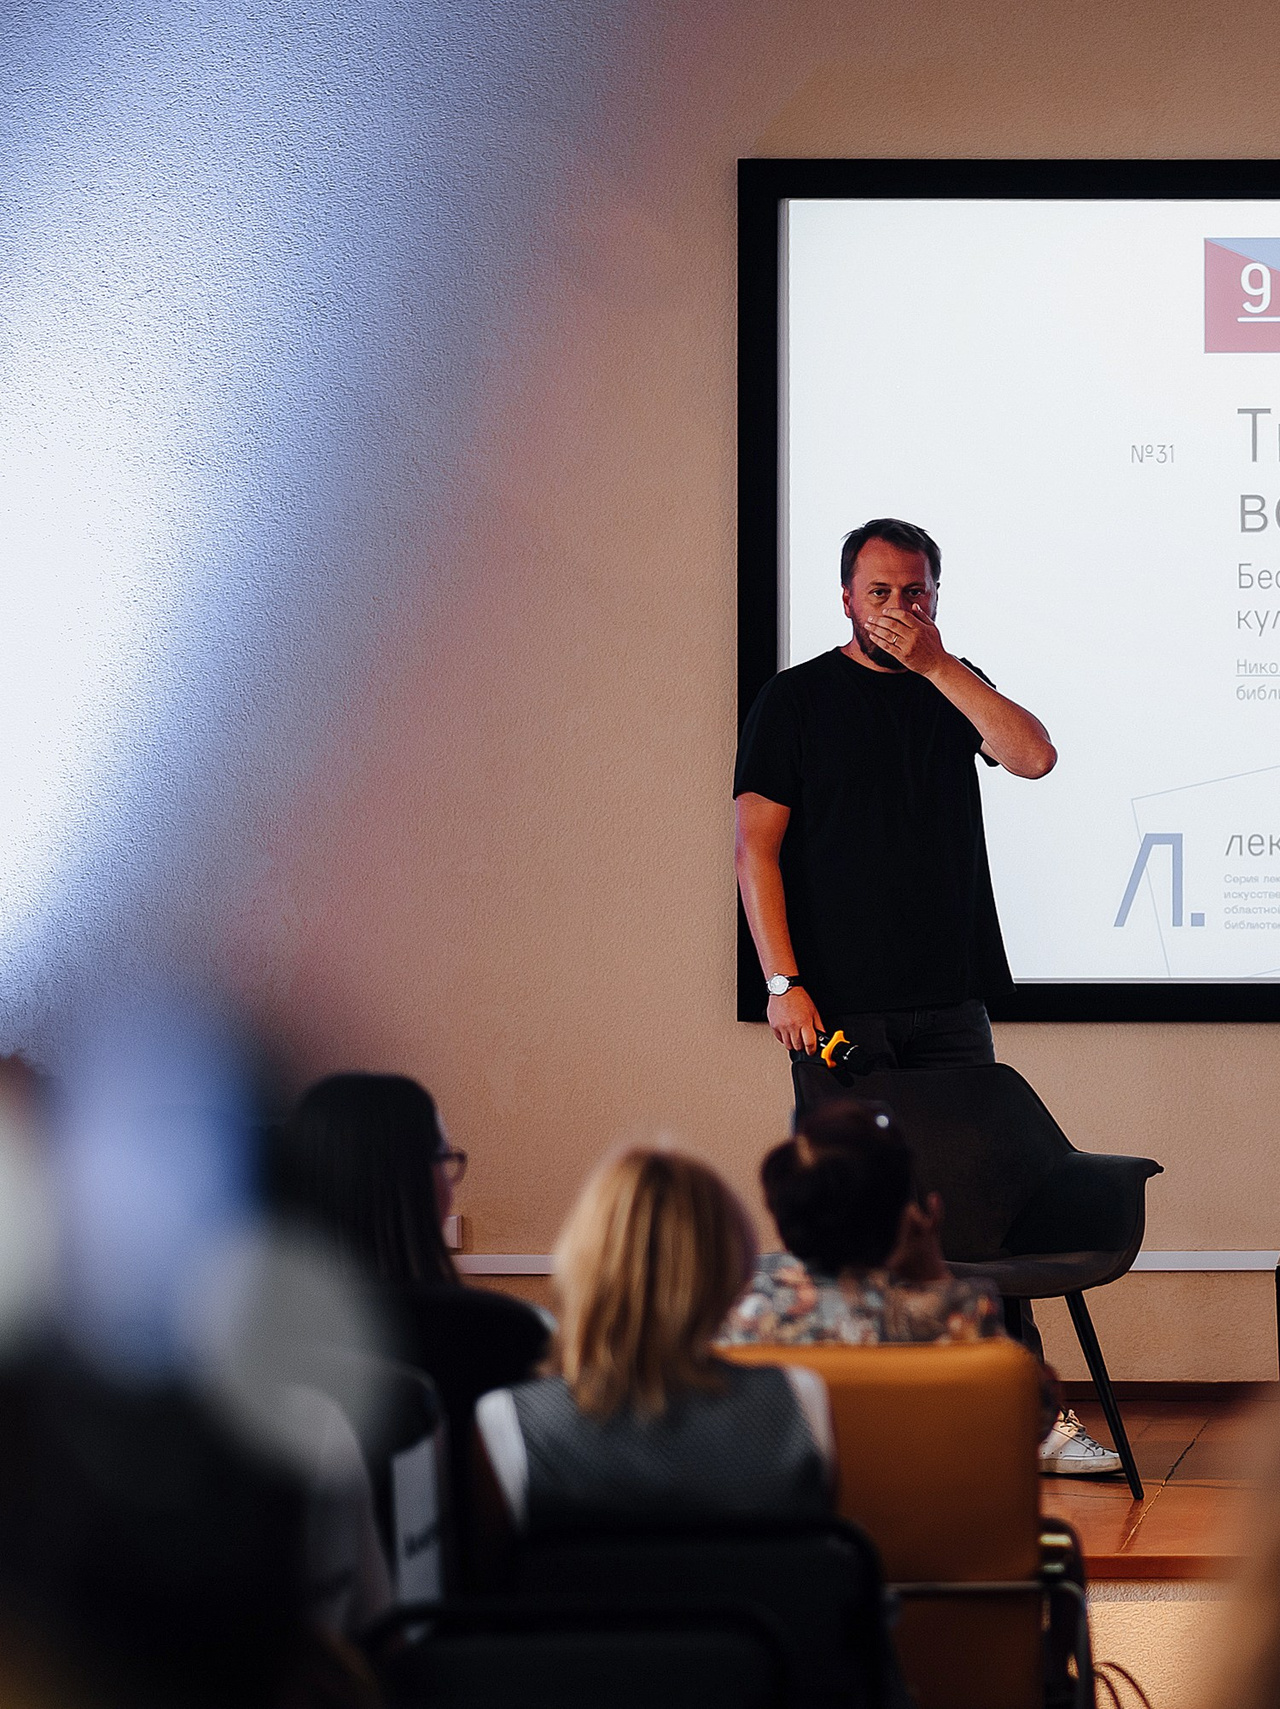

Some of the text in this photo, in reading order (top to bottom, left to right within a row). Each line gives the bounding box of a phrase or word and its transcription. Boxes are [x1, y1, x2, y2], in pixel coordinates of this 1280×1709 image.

[1240, 262, 1272, 314] 9
[1130, 443, 1175, 464] №31
[1223, 873, 1260, 885] Серия
